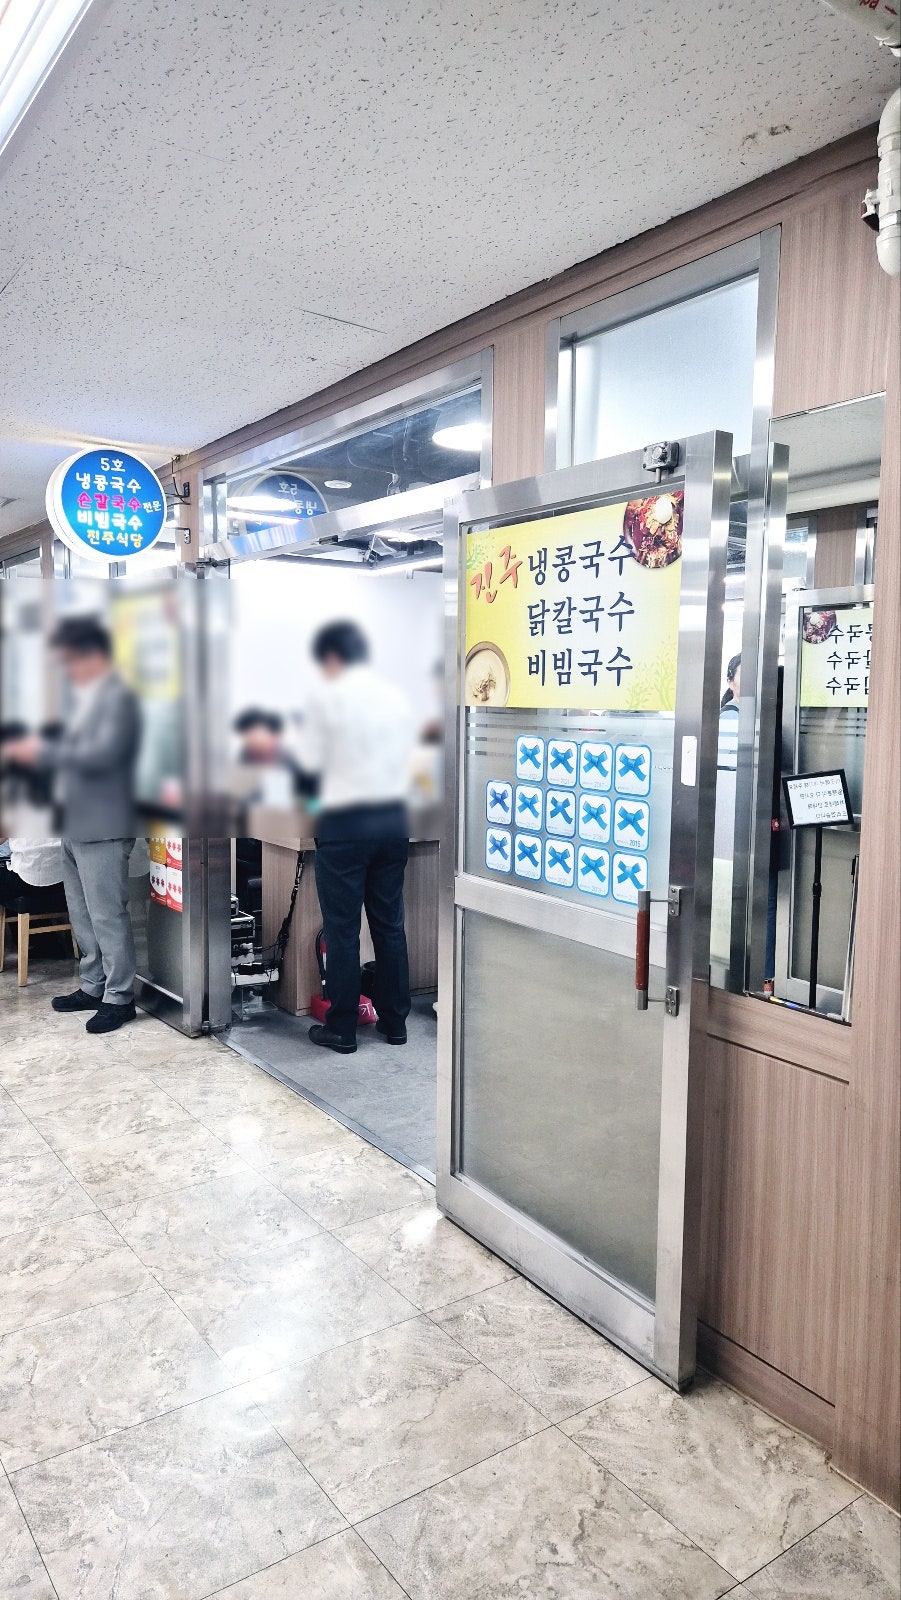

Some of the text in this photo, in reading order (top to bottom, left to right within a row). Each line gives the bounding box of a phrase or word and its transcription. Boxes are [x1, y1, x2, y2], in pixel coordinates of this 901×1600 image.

[100, 457, 125, 472] 5호
[75, 472, 141, 494] 냉콩국수
[76, 491, 162, 513] 손칼국수 전문
[76, 509, 143, 531] 비빔국수
[86, 529, 143, 548] 진주식당
[470, 535, 635, 604] 진주 냉콩국수
[527, 592, 635, 636] 닭칼국수
[527, 647, 634, 686] 비빔국수
[629, 839, 641, 848] 2015
